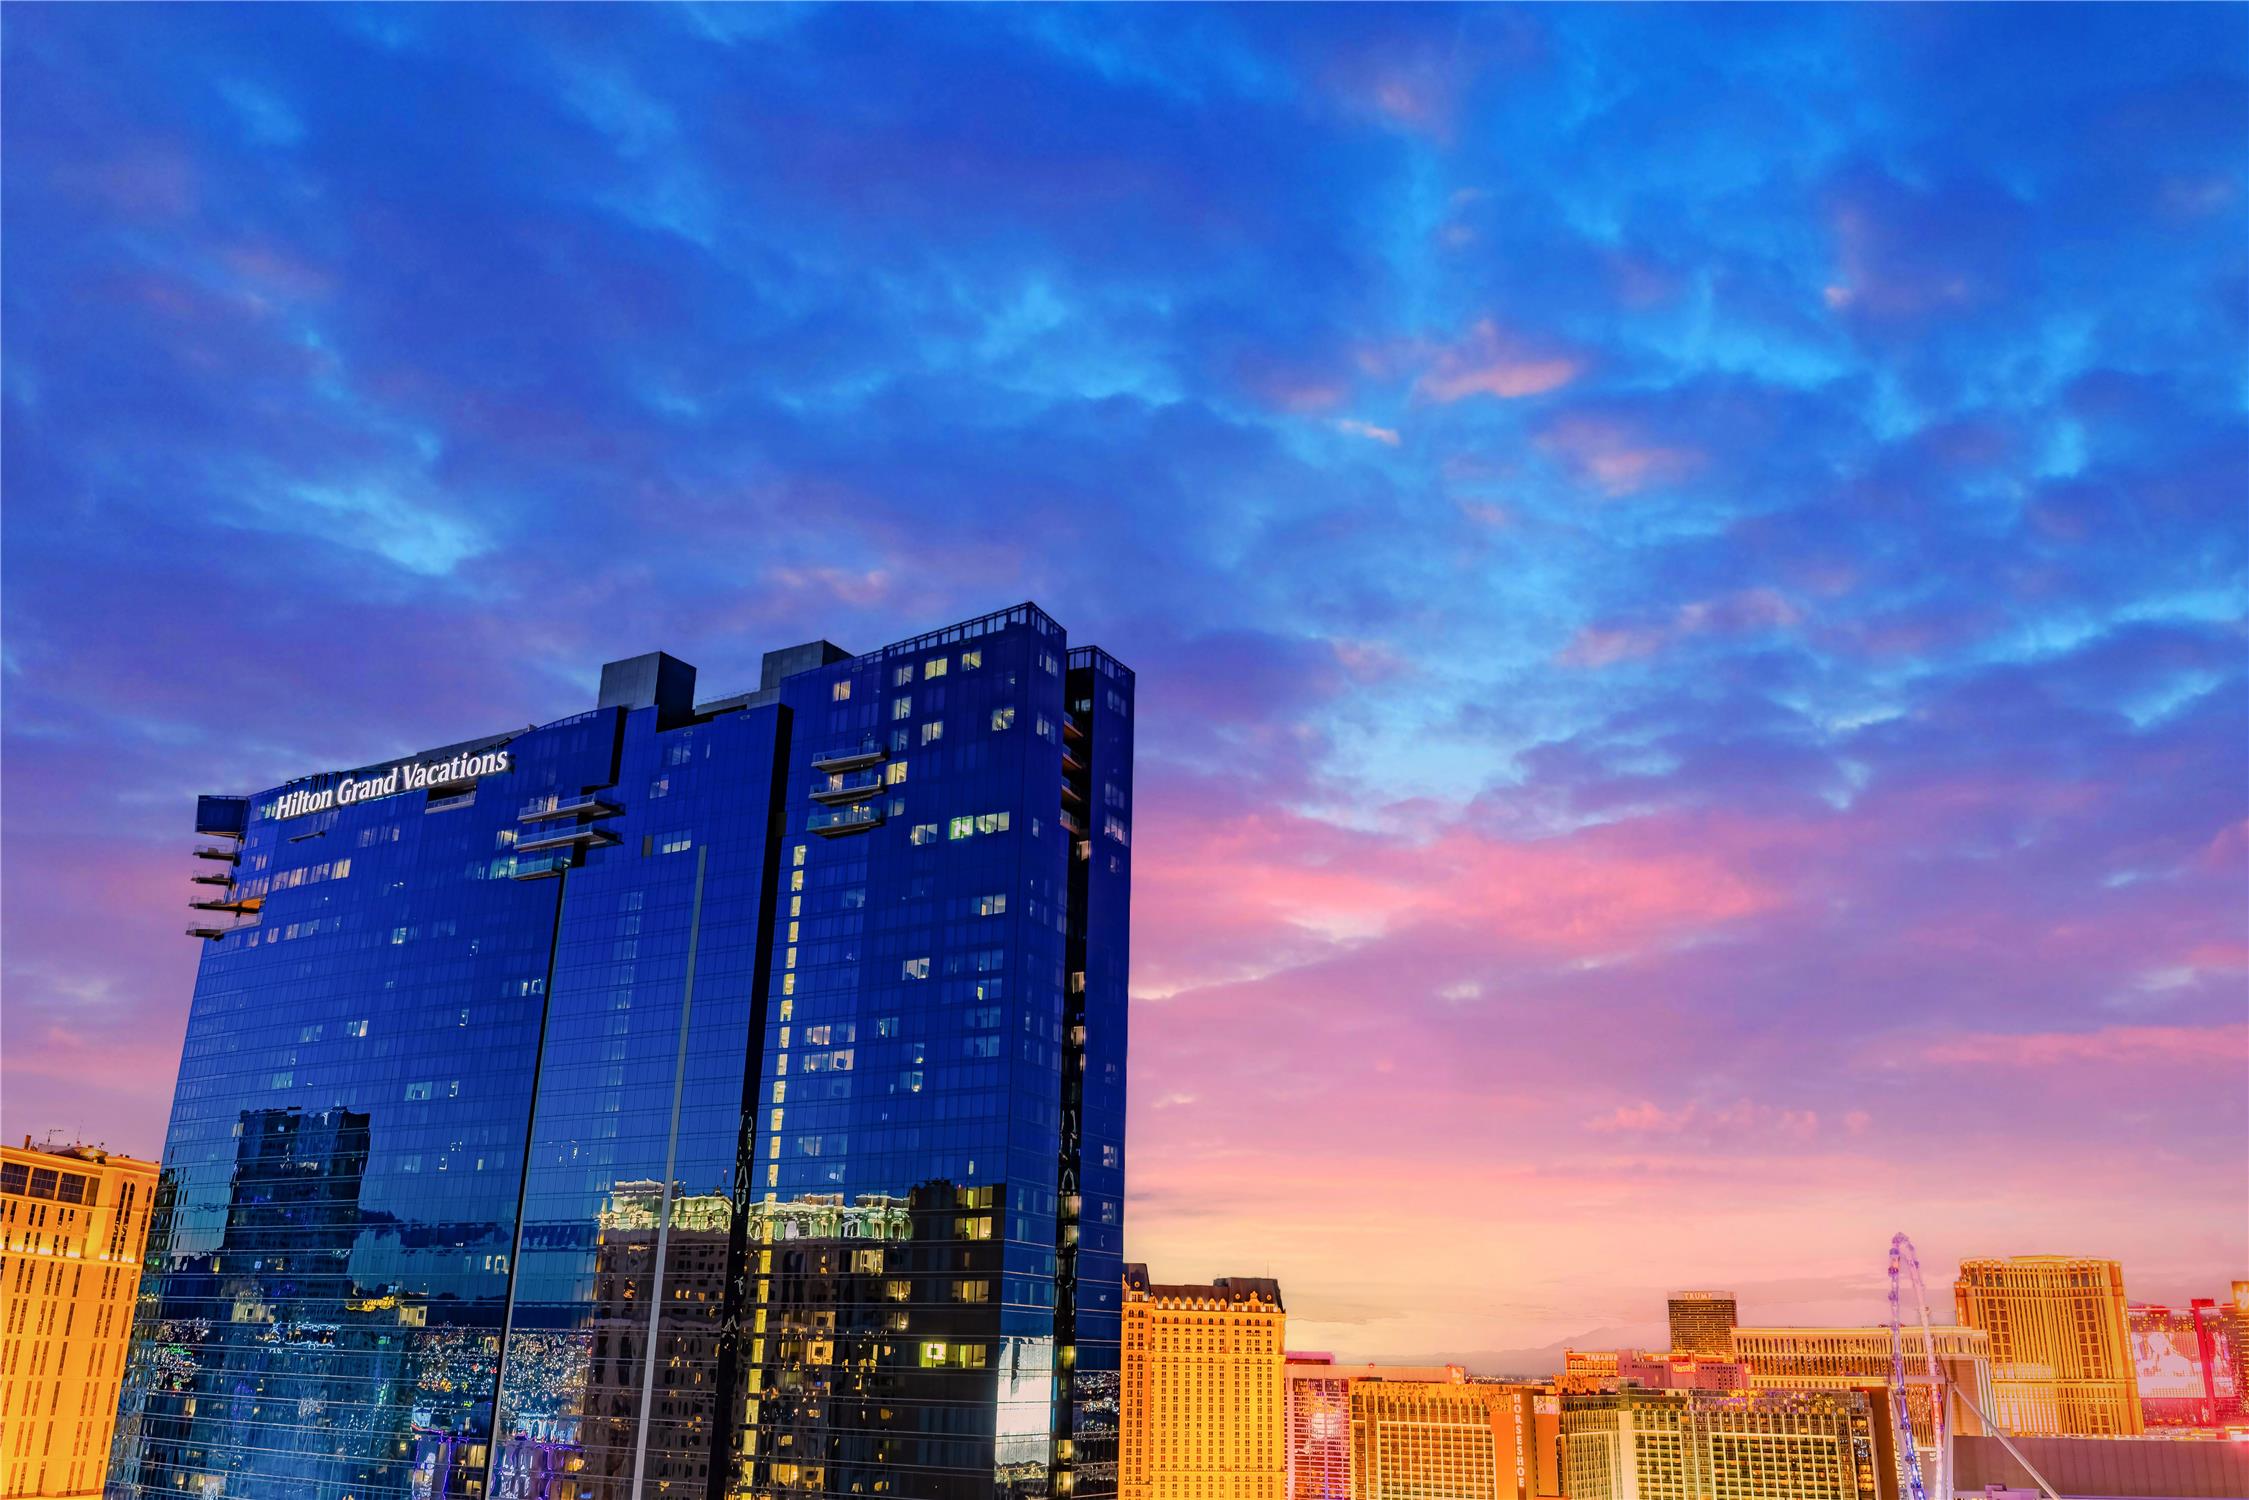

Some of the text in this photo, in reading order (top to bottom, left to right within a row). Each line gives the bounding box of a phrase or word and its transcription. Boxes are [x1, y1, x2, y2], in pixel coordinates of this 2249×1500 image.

[275, 751, 508, 820] Hilton Grand Vacations
[1684, 1292, 1712, 1300] TRUMP
[1513, 1393, 1526, 1487] HORSESHOE
